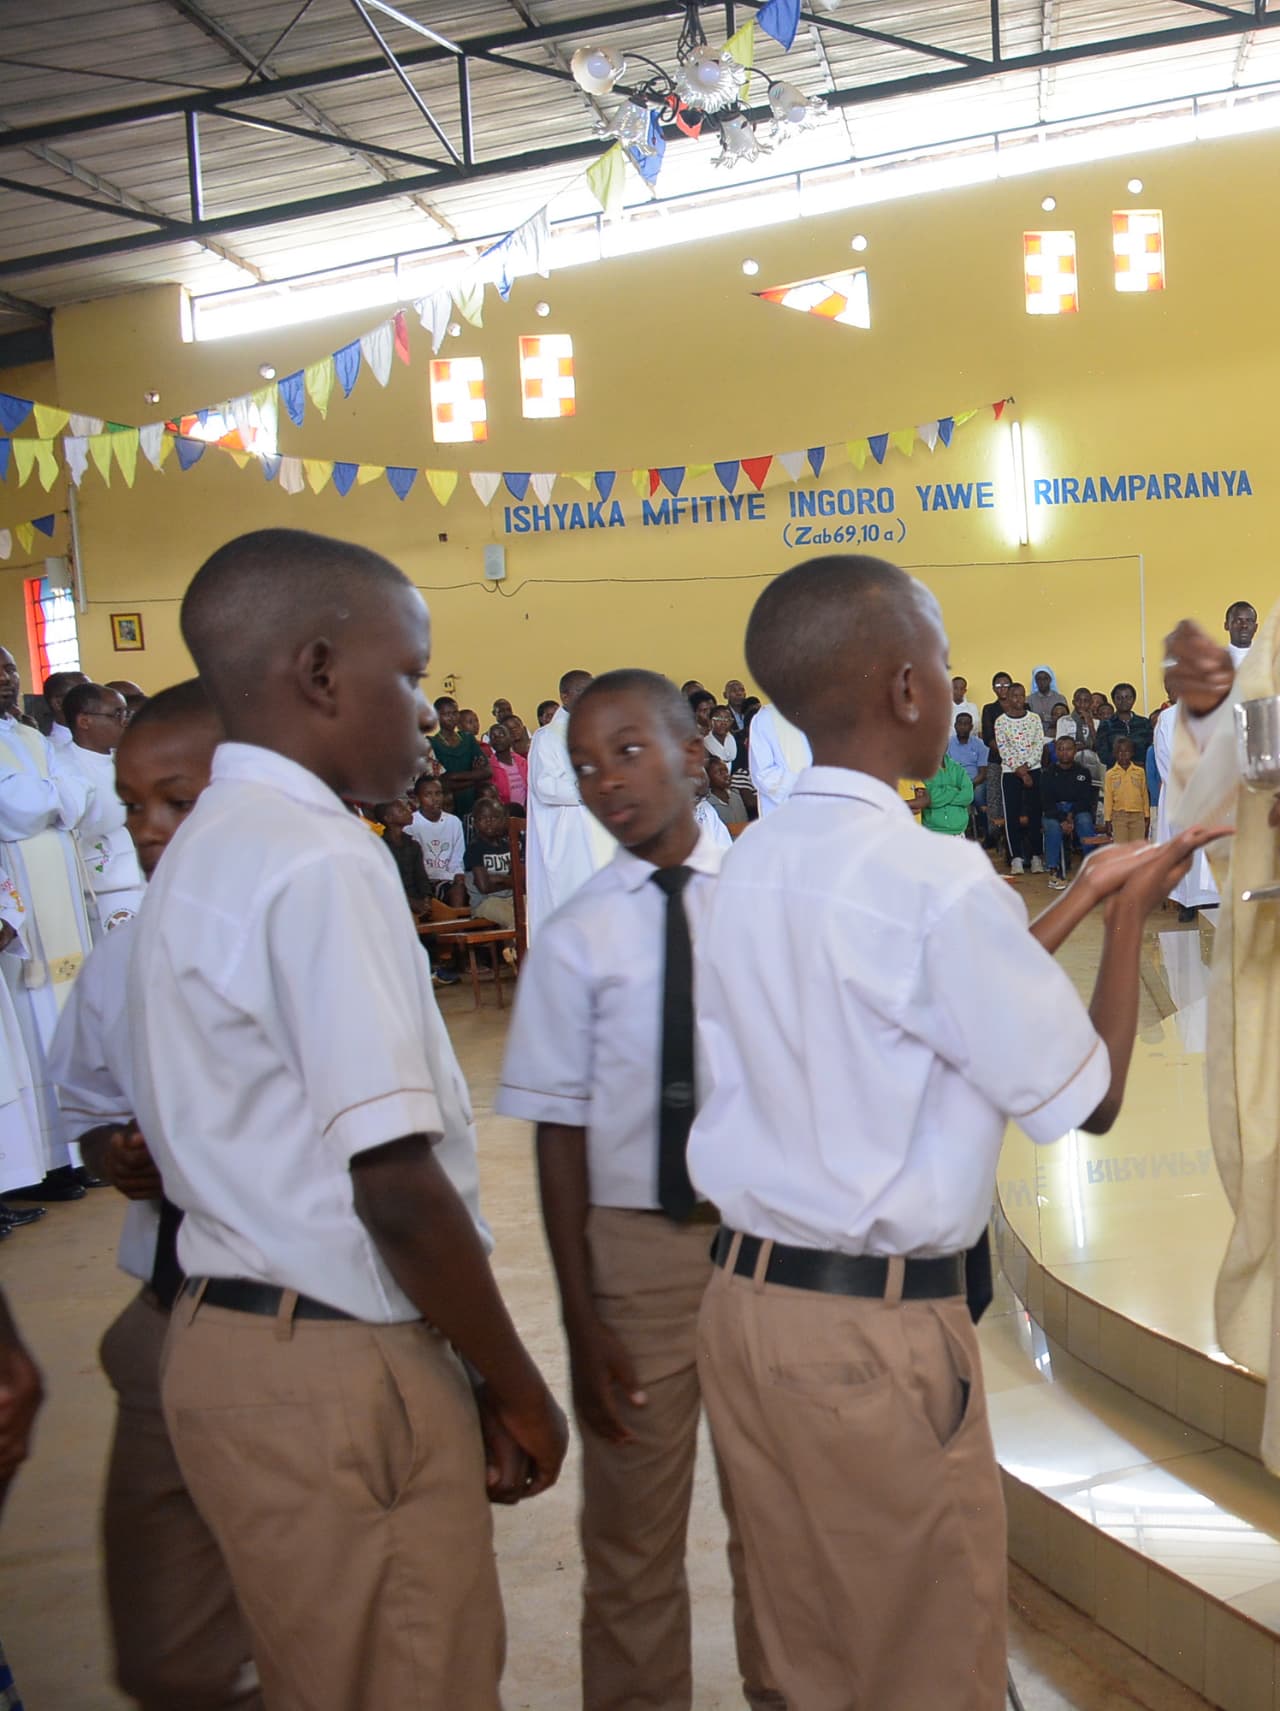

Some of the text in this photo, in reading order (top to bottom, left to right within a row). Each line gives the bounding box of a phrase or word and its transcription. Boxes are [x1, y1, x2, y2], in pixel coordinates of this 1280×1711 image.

[504, 470, 1253, 533] ISHYAKA MFITIYE INGORO YAWE RIRAMPARANYA
